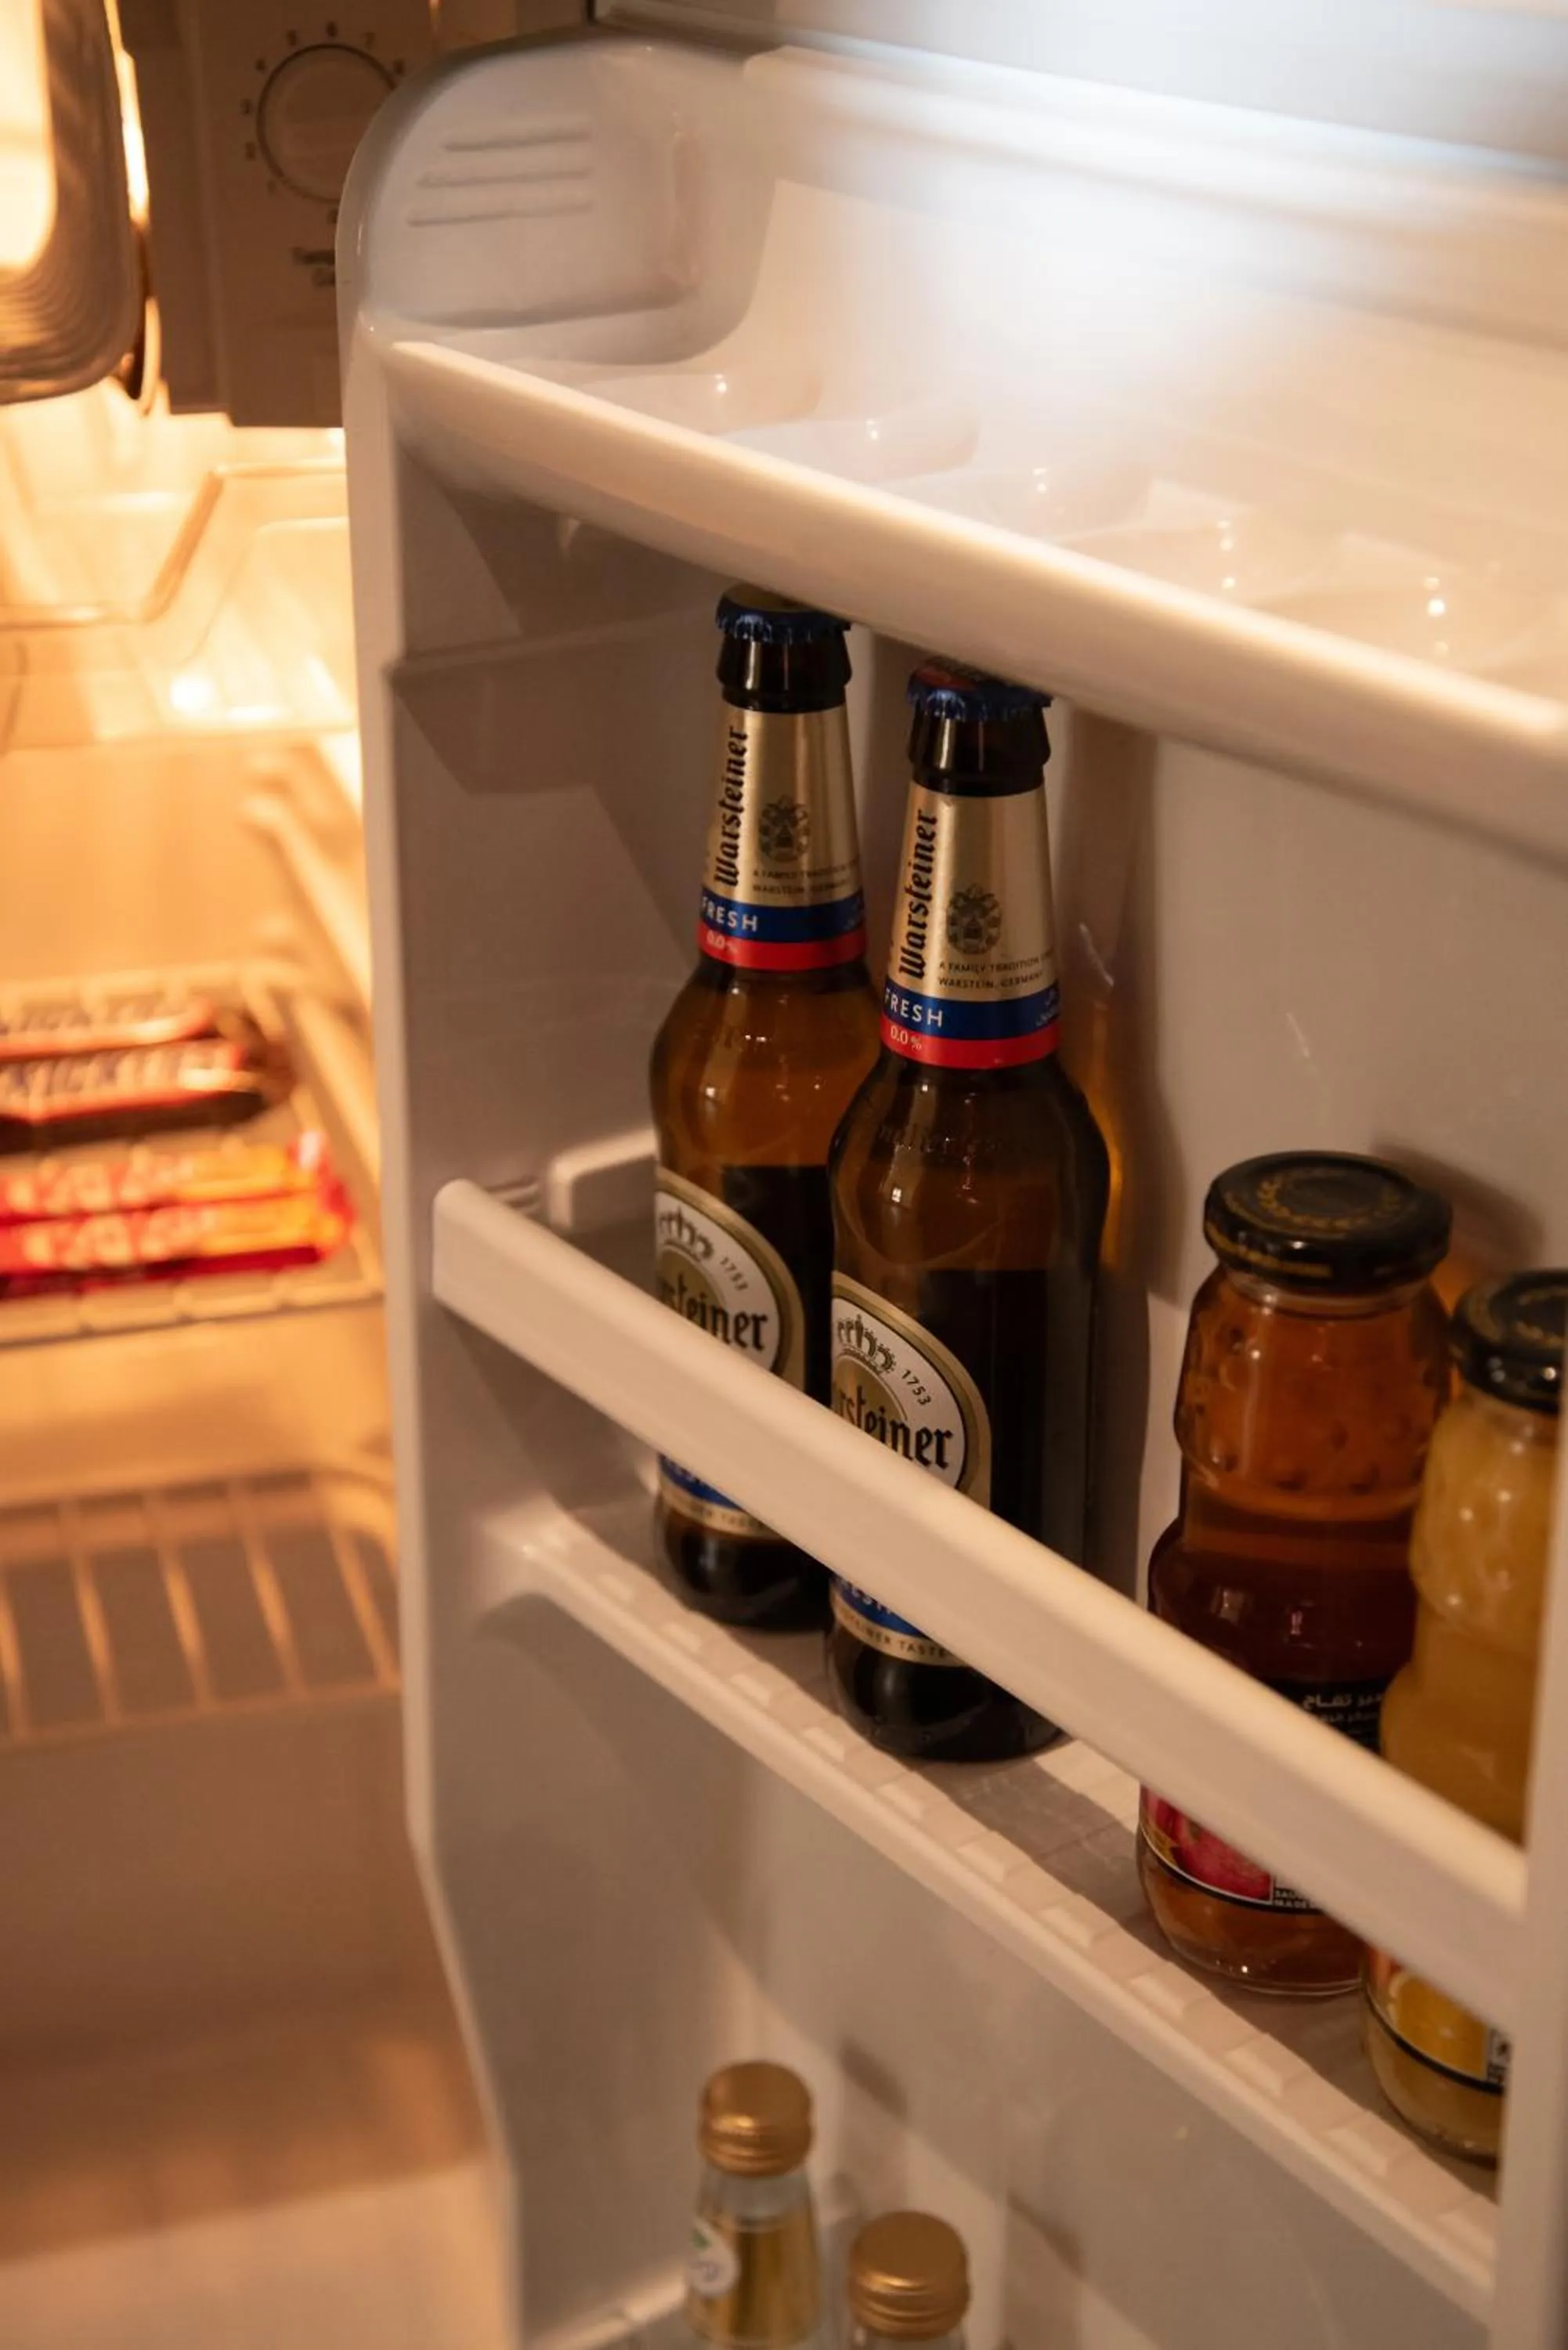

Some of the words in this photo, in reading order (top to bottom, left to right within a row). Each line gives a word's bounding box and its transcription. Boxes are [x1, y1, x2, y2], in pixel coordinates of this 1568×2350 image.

[714, 726, 748, 888] Warsteiner
[899, 808, 938, 979] Warsteiner
[702, 896, 758, 932] FRESH
[884, 988, 944, 1028] FRESH
[720, 1256, 748, 1291] 1753
[902, 1369, 931, 1405] 1753
[834, 1386, 953, 1470] rsteiner
